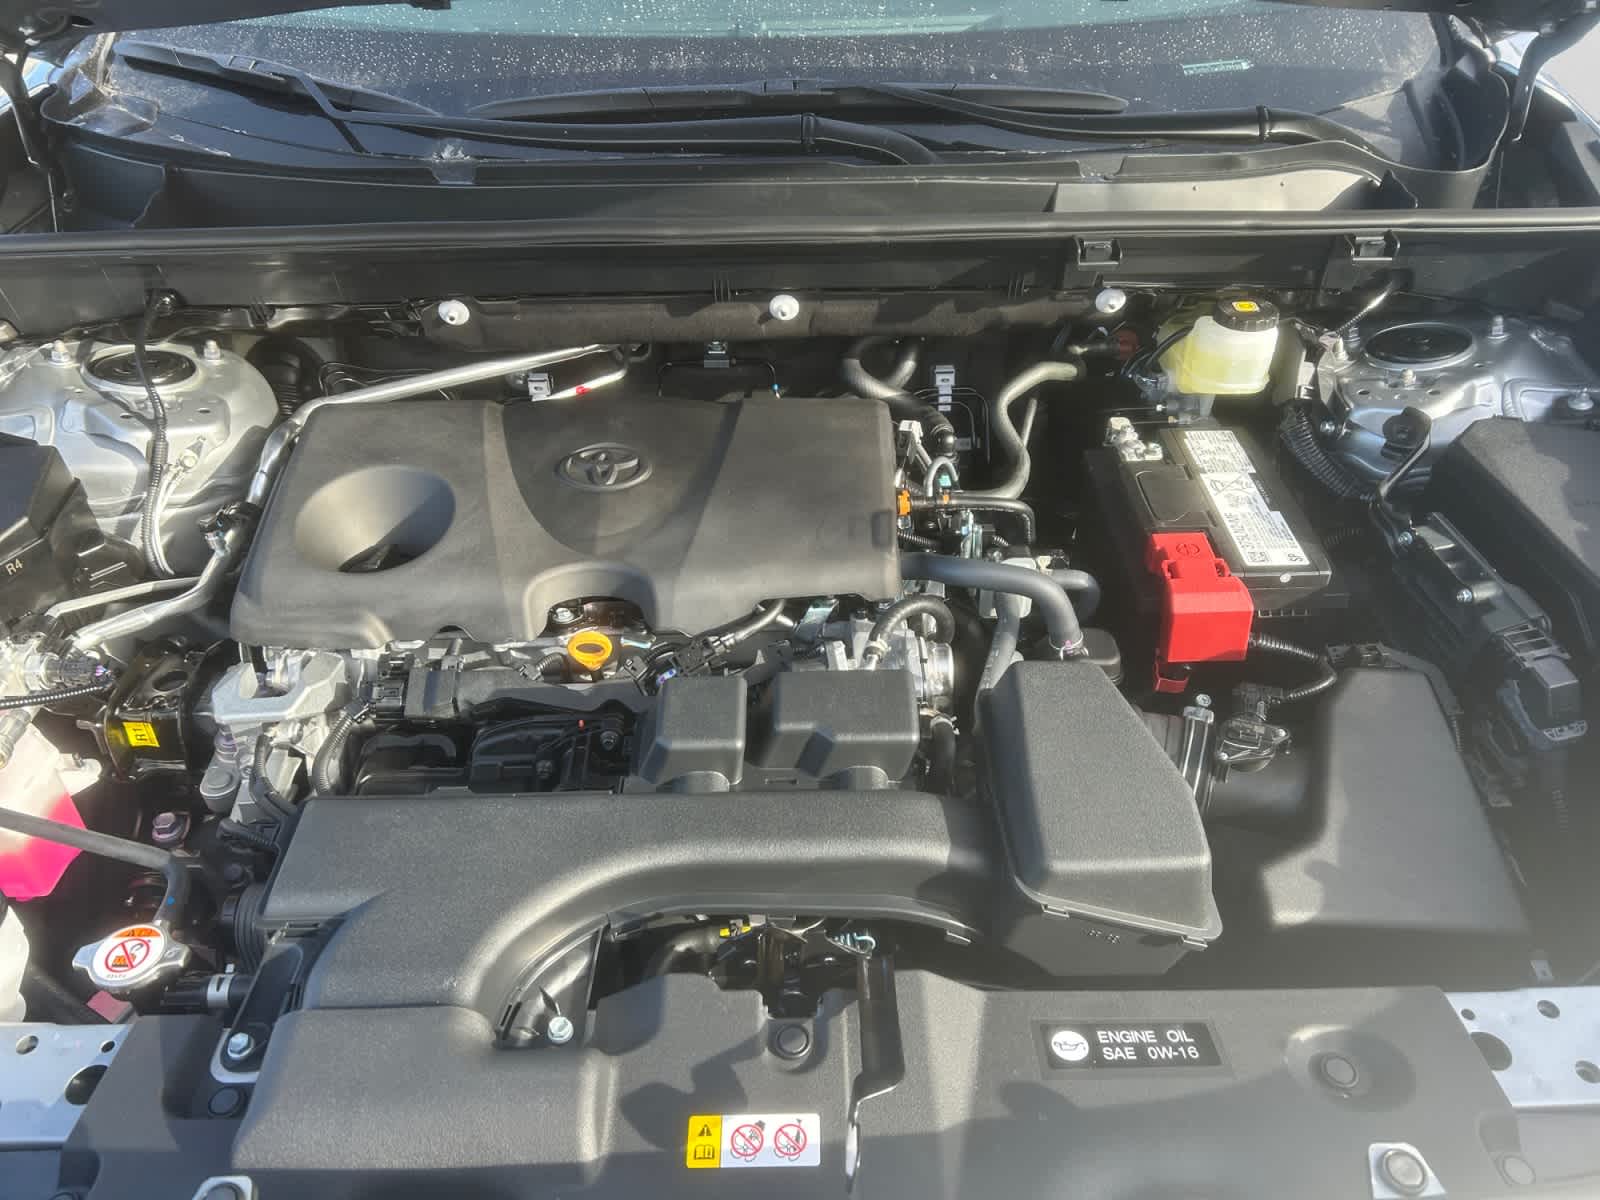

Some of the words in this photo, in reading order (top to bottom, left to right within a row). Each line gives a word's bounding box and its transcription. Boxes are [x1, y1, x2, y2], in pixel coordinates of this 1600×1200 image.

[6, 558, 23, 575] R4
[1097, 1030, 1157, 1043] ENGINE
[1166, 1029, 1195, 1042] OIL
[1103, 1047, 1137, 1060] SAE
[1147, 1046, 1200, 1060] 0W-16
